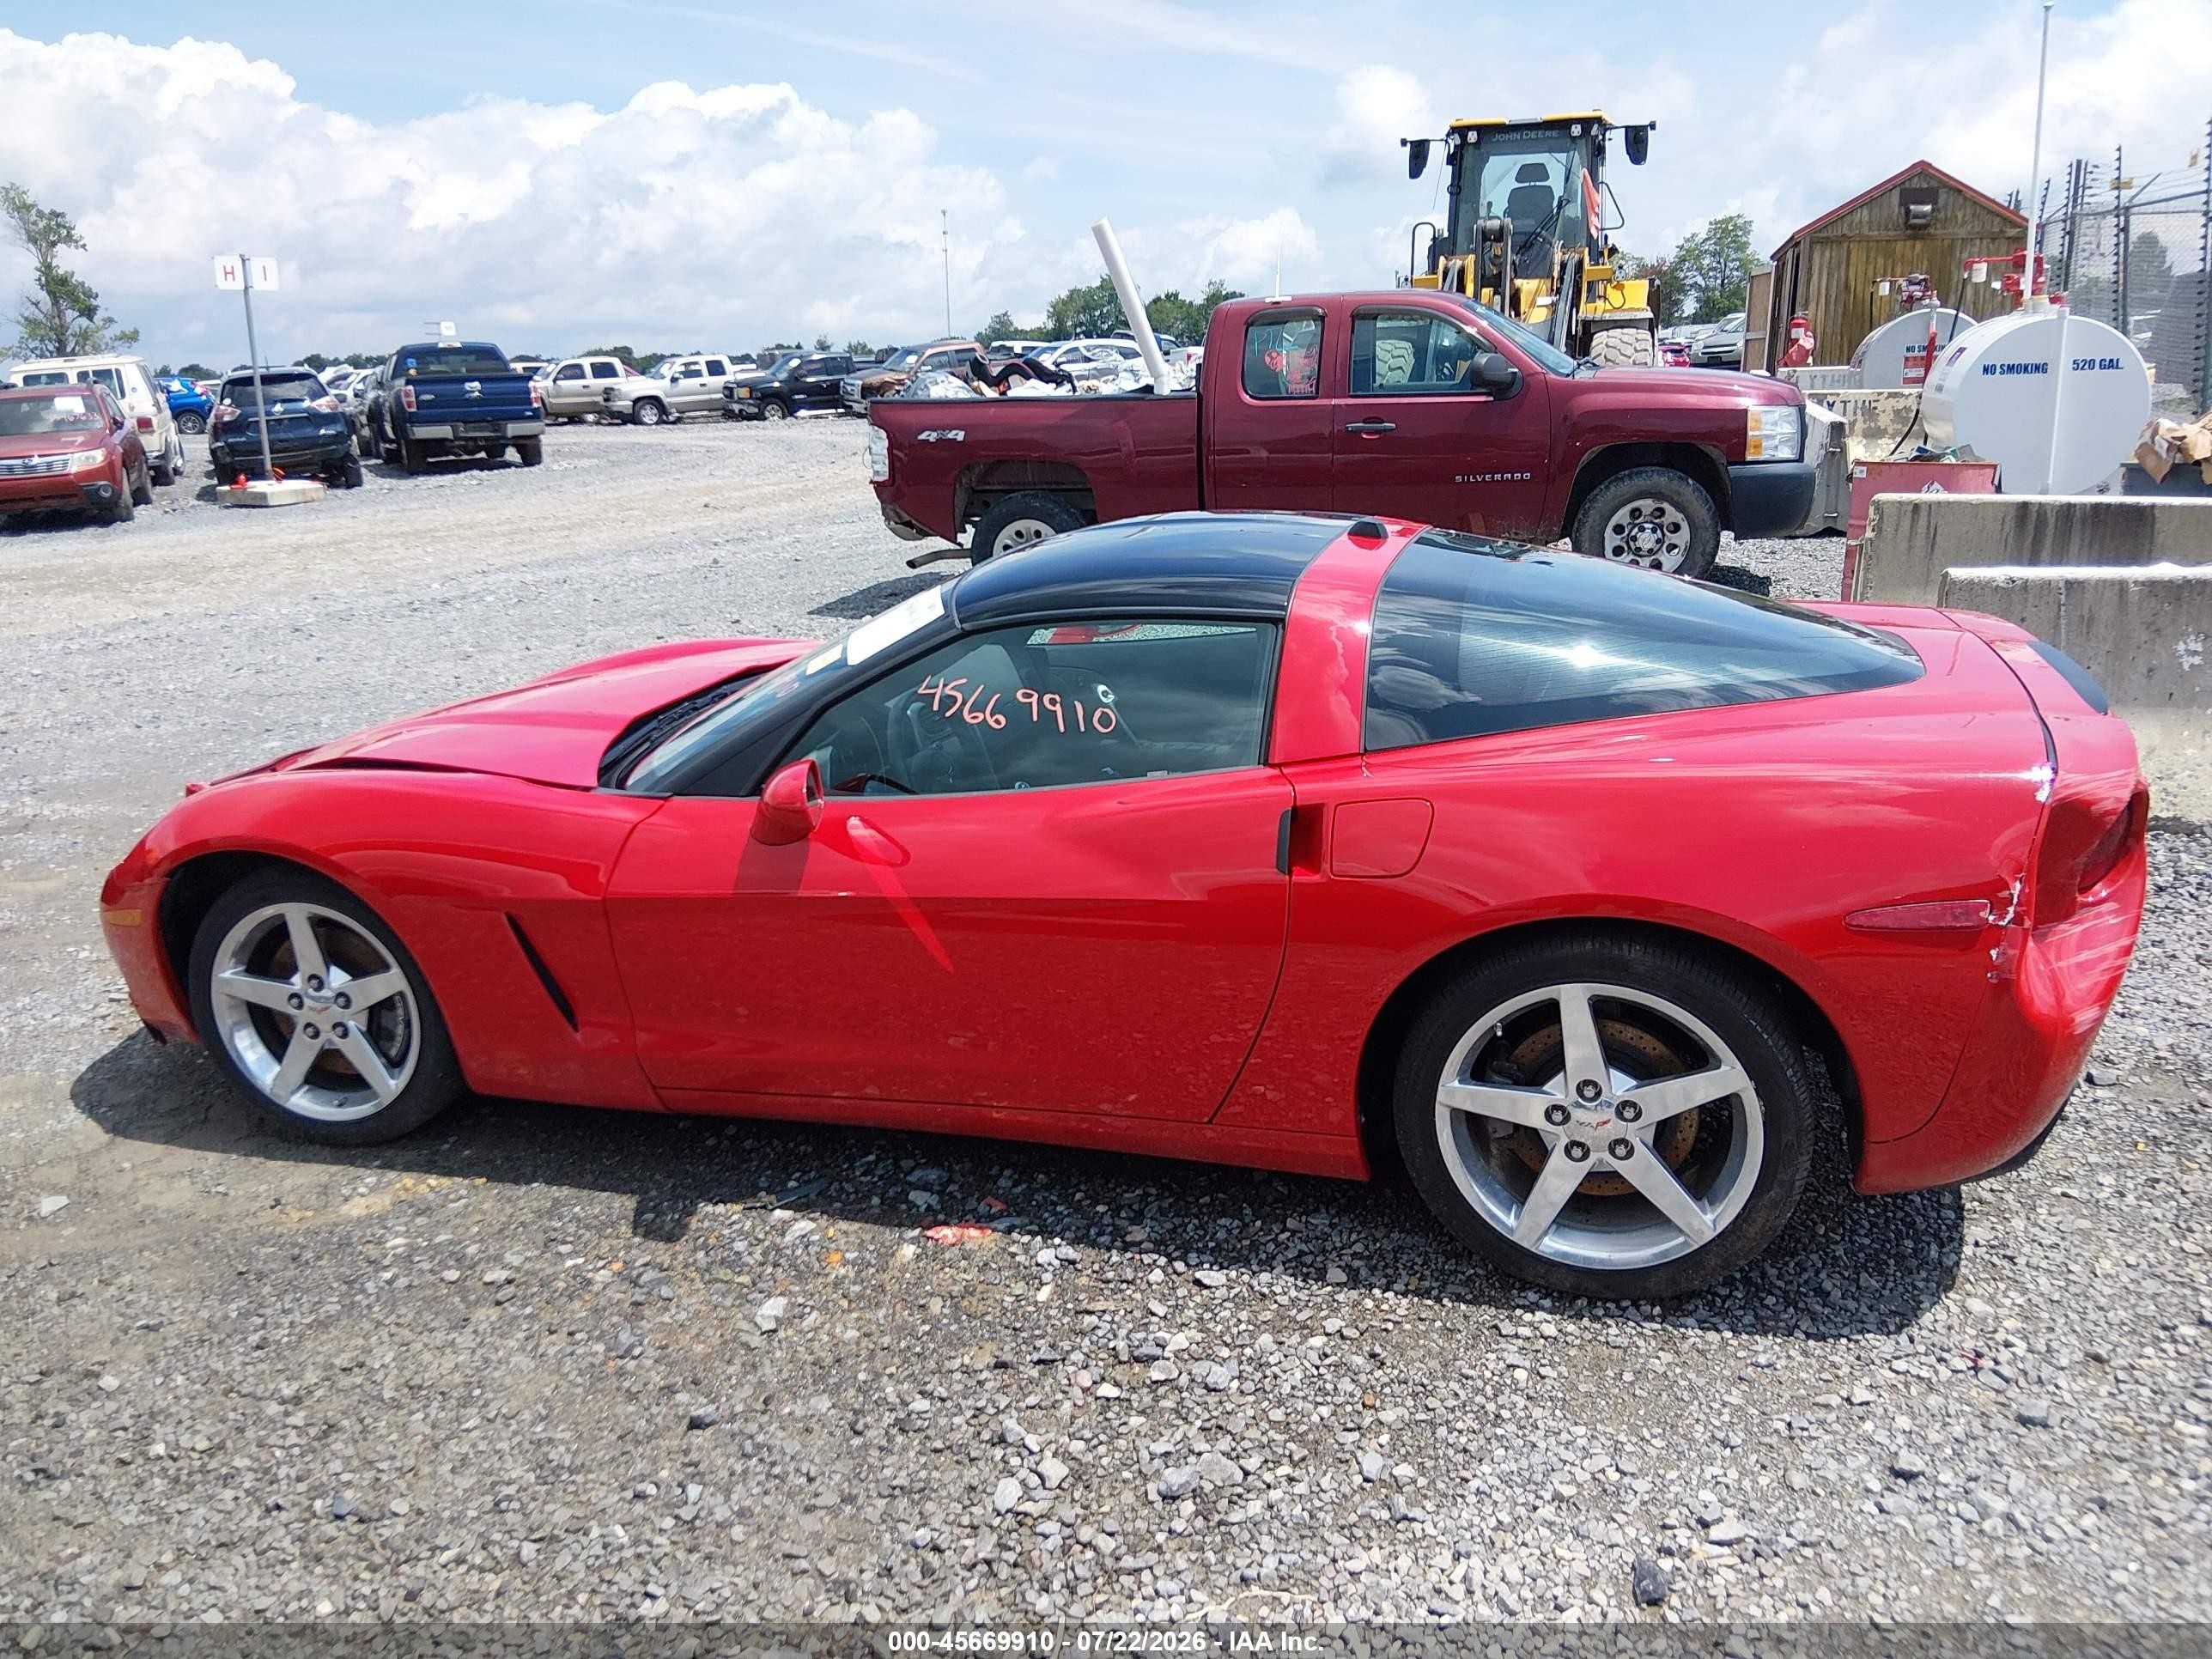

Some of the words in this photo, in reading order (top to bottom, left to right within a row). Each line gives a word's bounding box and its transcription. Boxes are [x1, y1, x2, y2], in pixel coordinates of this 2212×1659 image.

[1492, 131, 1521, 142] JOHN
[1522, 130, 1559, 140] DEERE
[223, 264, 236, 282] H
[1982, 363, 1997, 375] NO
[1999, 362, 2049, 375] SMOKING
[2071, 358, 2096, 371] 520
[2099, 357, 2124, 370] GAL
[1455, 472, 1531, 483] SILVERADO
